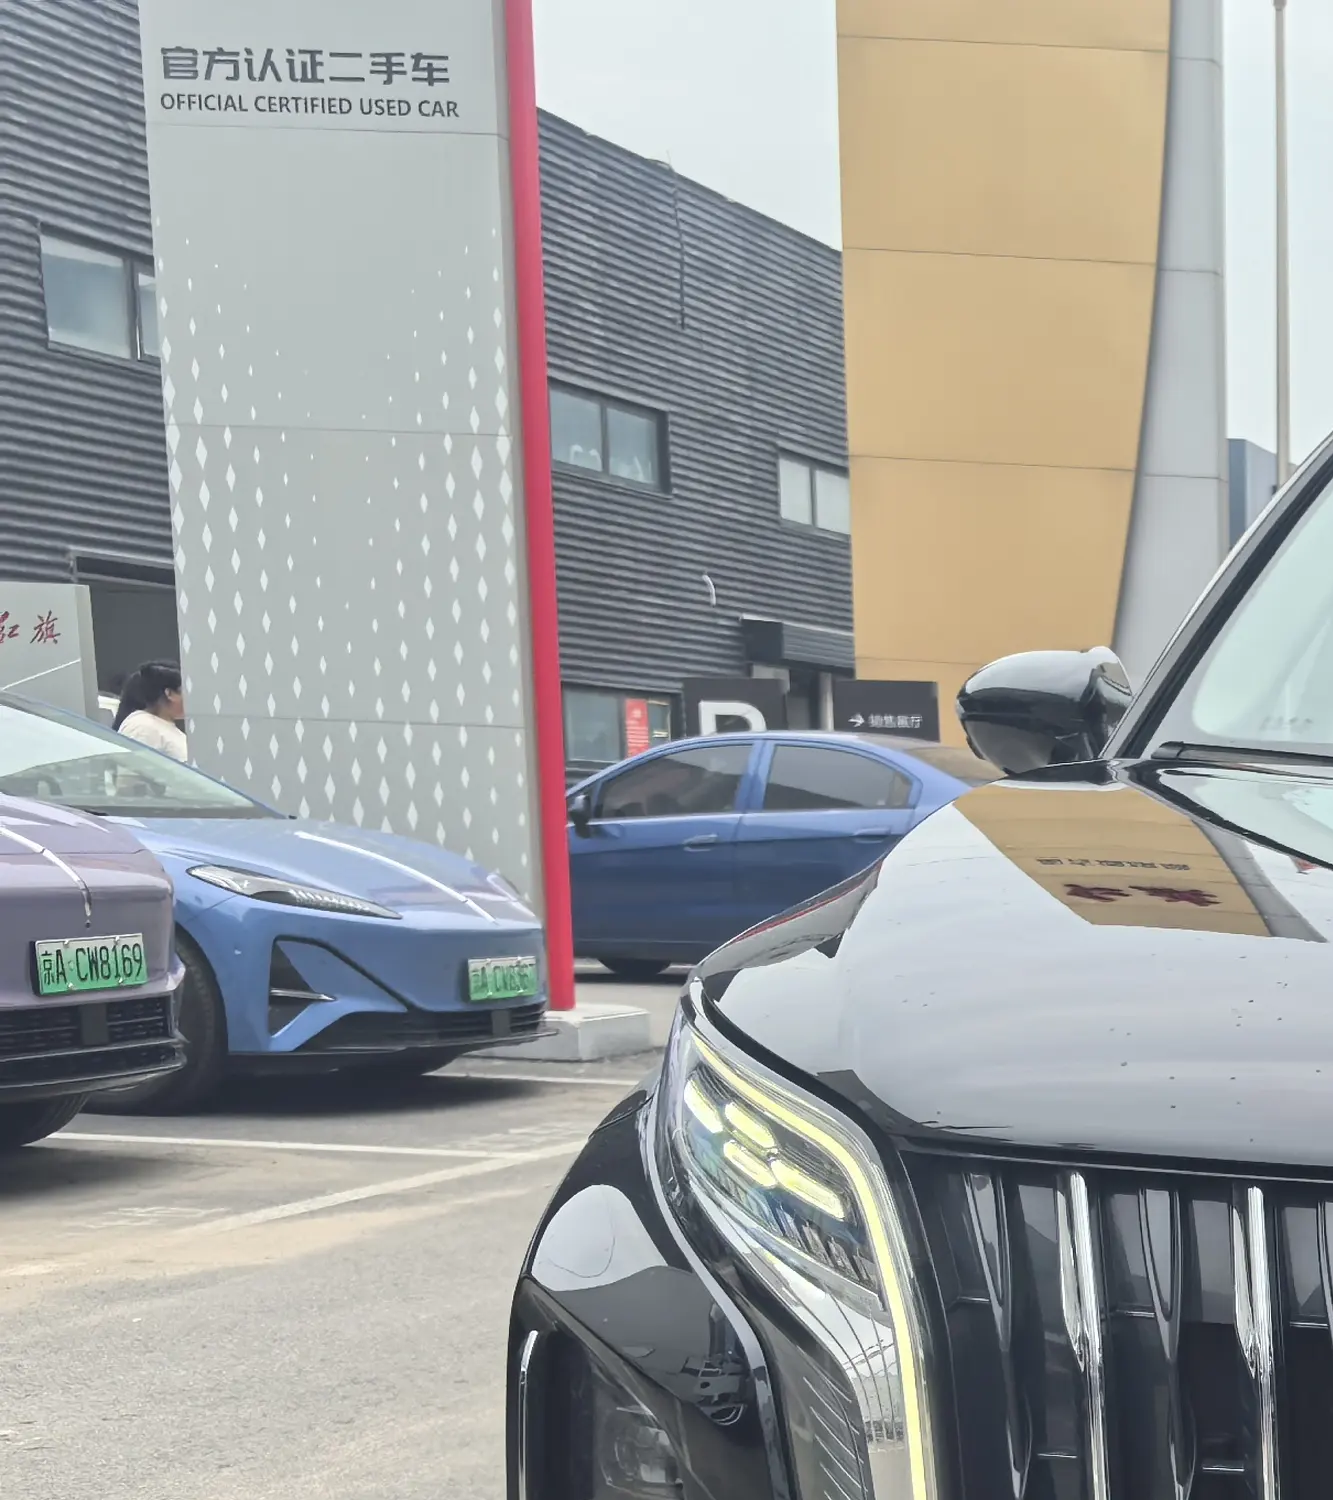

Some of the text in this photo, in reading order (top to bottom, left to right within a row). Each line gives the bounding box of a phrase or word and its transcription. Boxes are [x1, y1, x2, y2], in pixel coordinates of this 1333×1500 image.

[160, 46, 450, 86] 官方认证二手车
[160, 93, 460, 118] OFFICIAL CERTIFIED USED CAR
